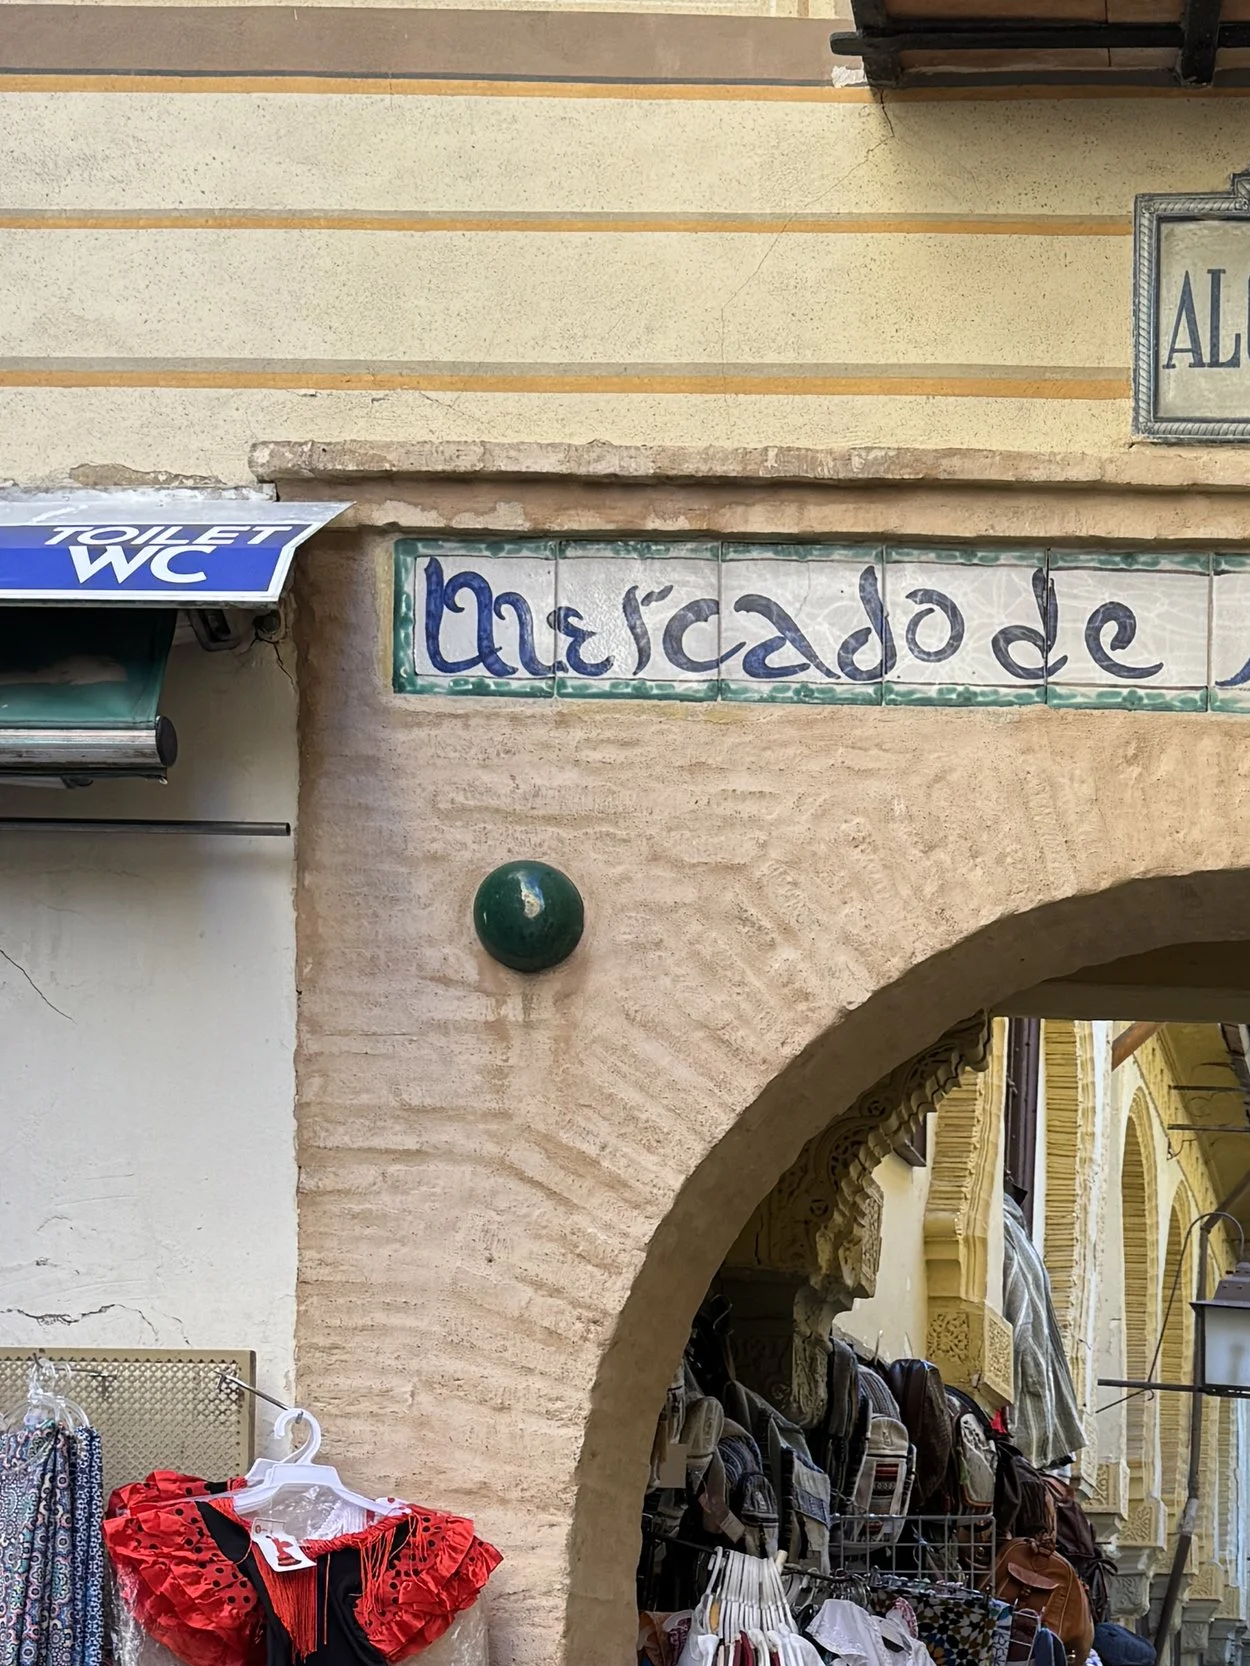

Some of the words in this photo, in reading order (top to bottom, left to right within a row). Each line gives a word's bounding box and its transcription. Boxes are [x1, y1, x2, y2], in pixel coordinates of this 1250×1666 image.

[44, 525, 293, 546] TOILET
[68, 545, 217, 584] WC
[422, 556, 966, 682] Mercado
[991, 567, 1165, 679] de
